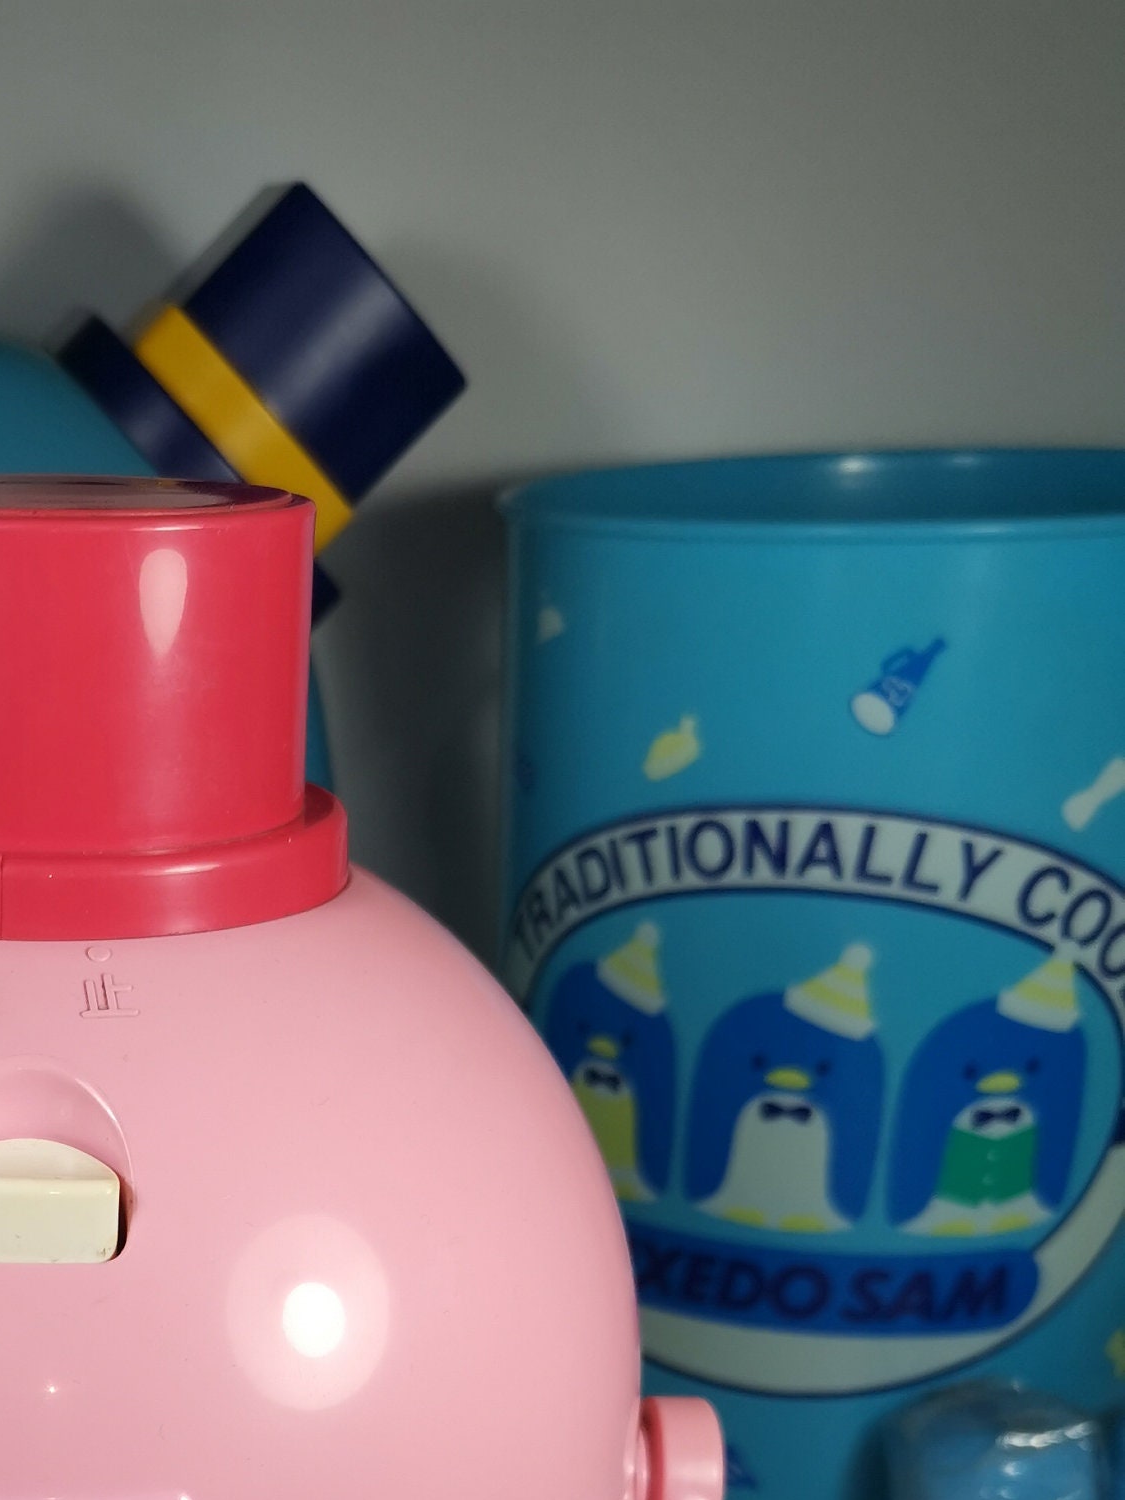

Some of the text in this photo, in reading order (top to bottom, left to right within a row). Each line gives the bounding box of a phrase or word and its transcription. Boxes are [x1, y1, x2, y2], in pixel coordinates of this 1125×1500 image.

[514, 819, 1125, 995] TRADITIONALLY COO
[80, 972, 140, 1018] 止
[636, 1240, 1010, 1323] XEDO SAM
